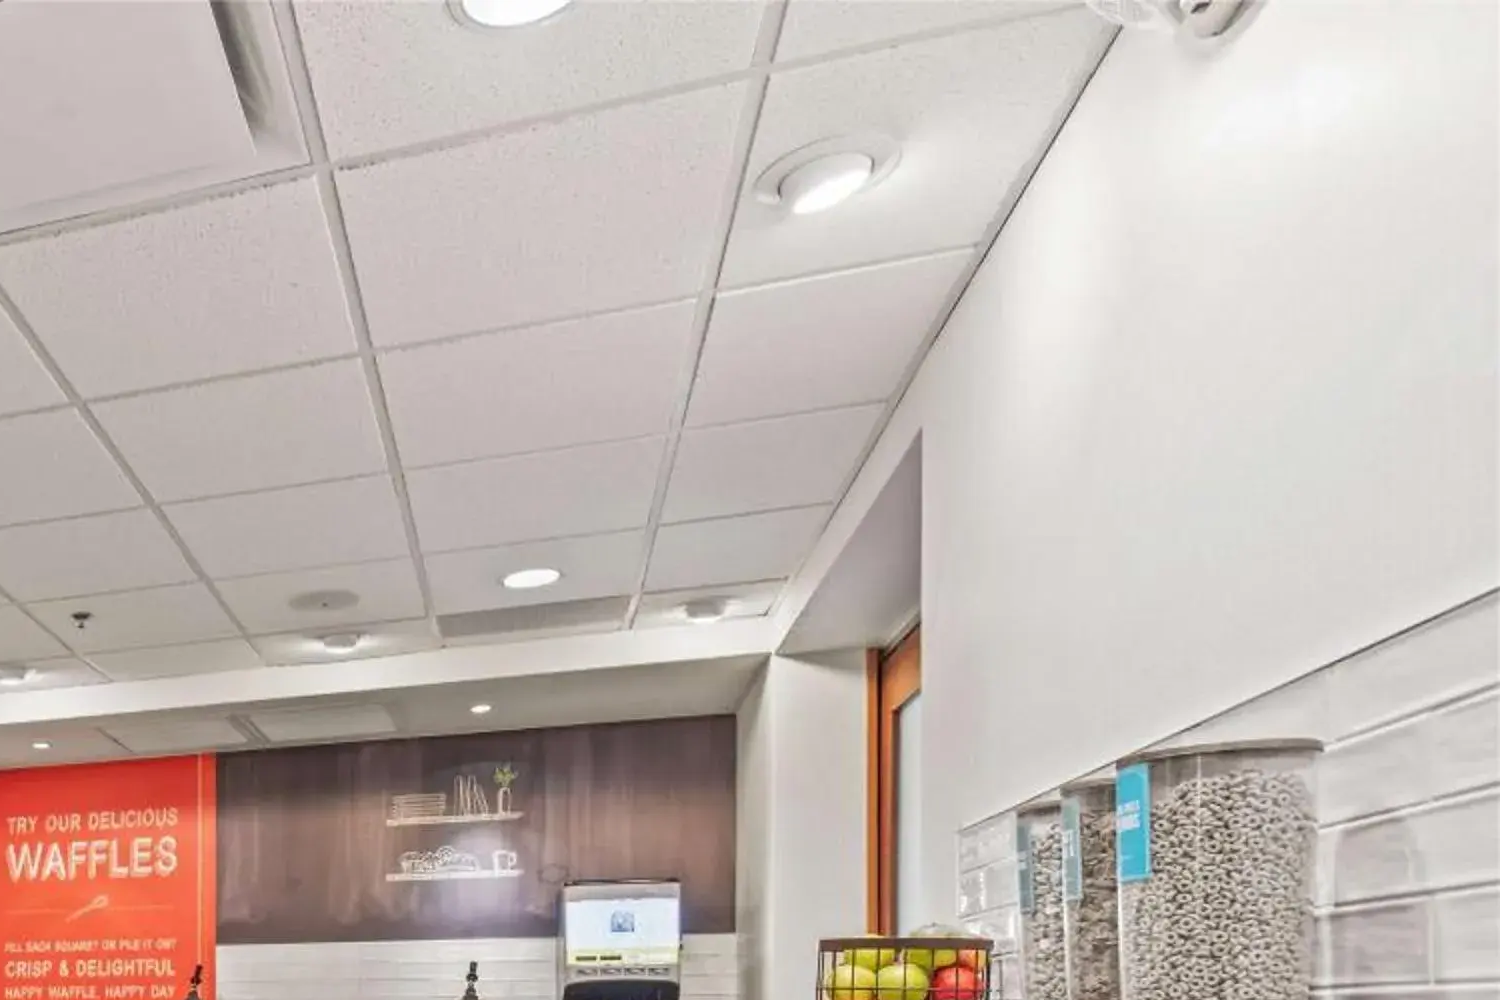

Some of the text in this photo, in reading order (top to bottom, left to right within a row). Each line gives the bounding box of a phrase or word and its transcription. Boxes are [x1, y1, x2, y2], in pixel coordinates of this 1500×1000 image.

[6, 807, 178, 836] TRY OUR DELICIOUS
[6, 836, 178, 882] WAFFLES
[4, 958, 176, 978] CRISP & DELIGHTFUL
[4, 985, 43, 999] HAPPY
[104, 984, 146, 999] HAPPY
[150, 984, 176, 999] DAY
